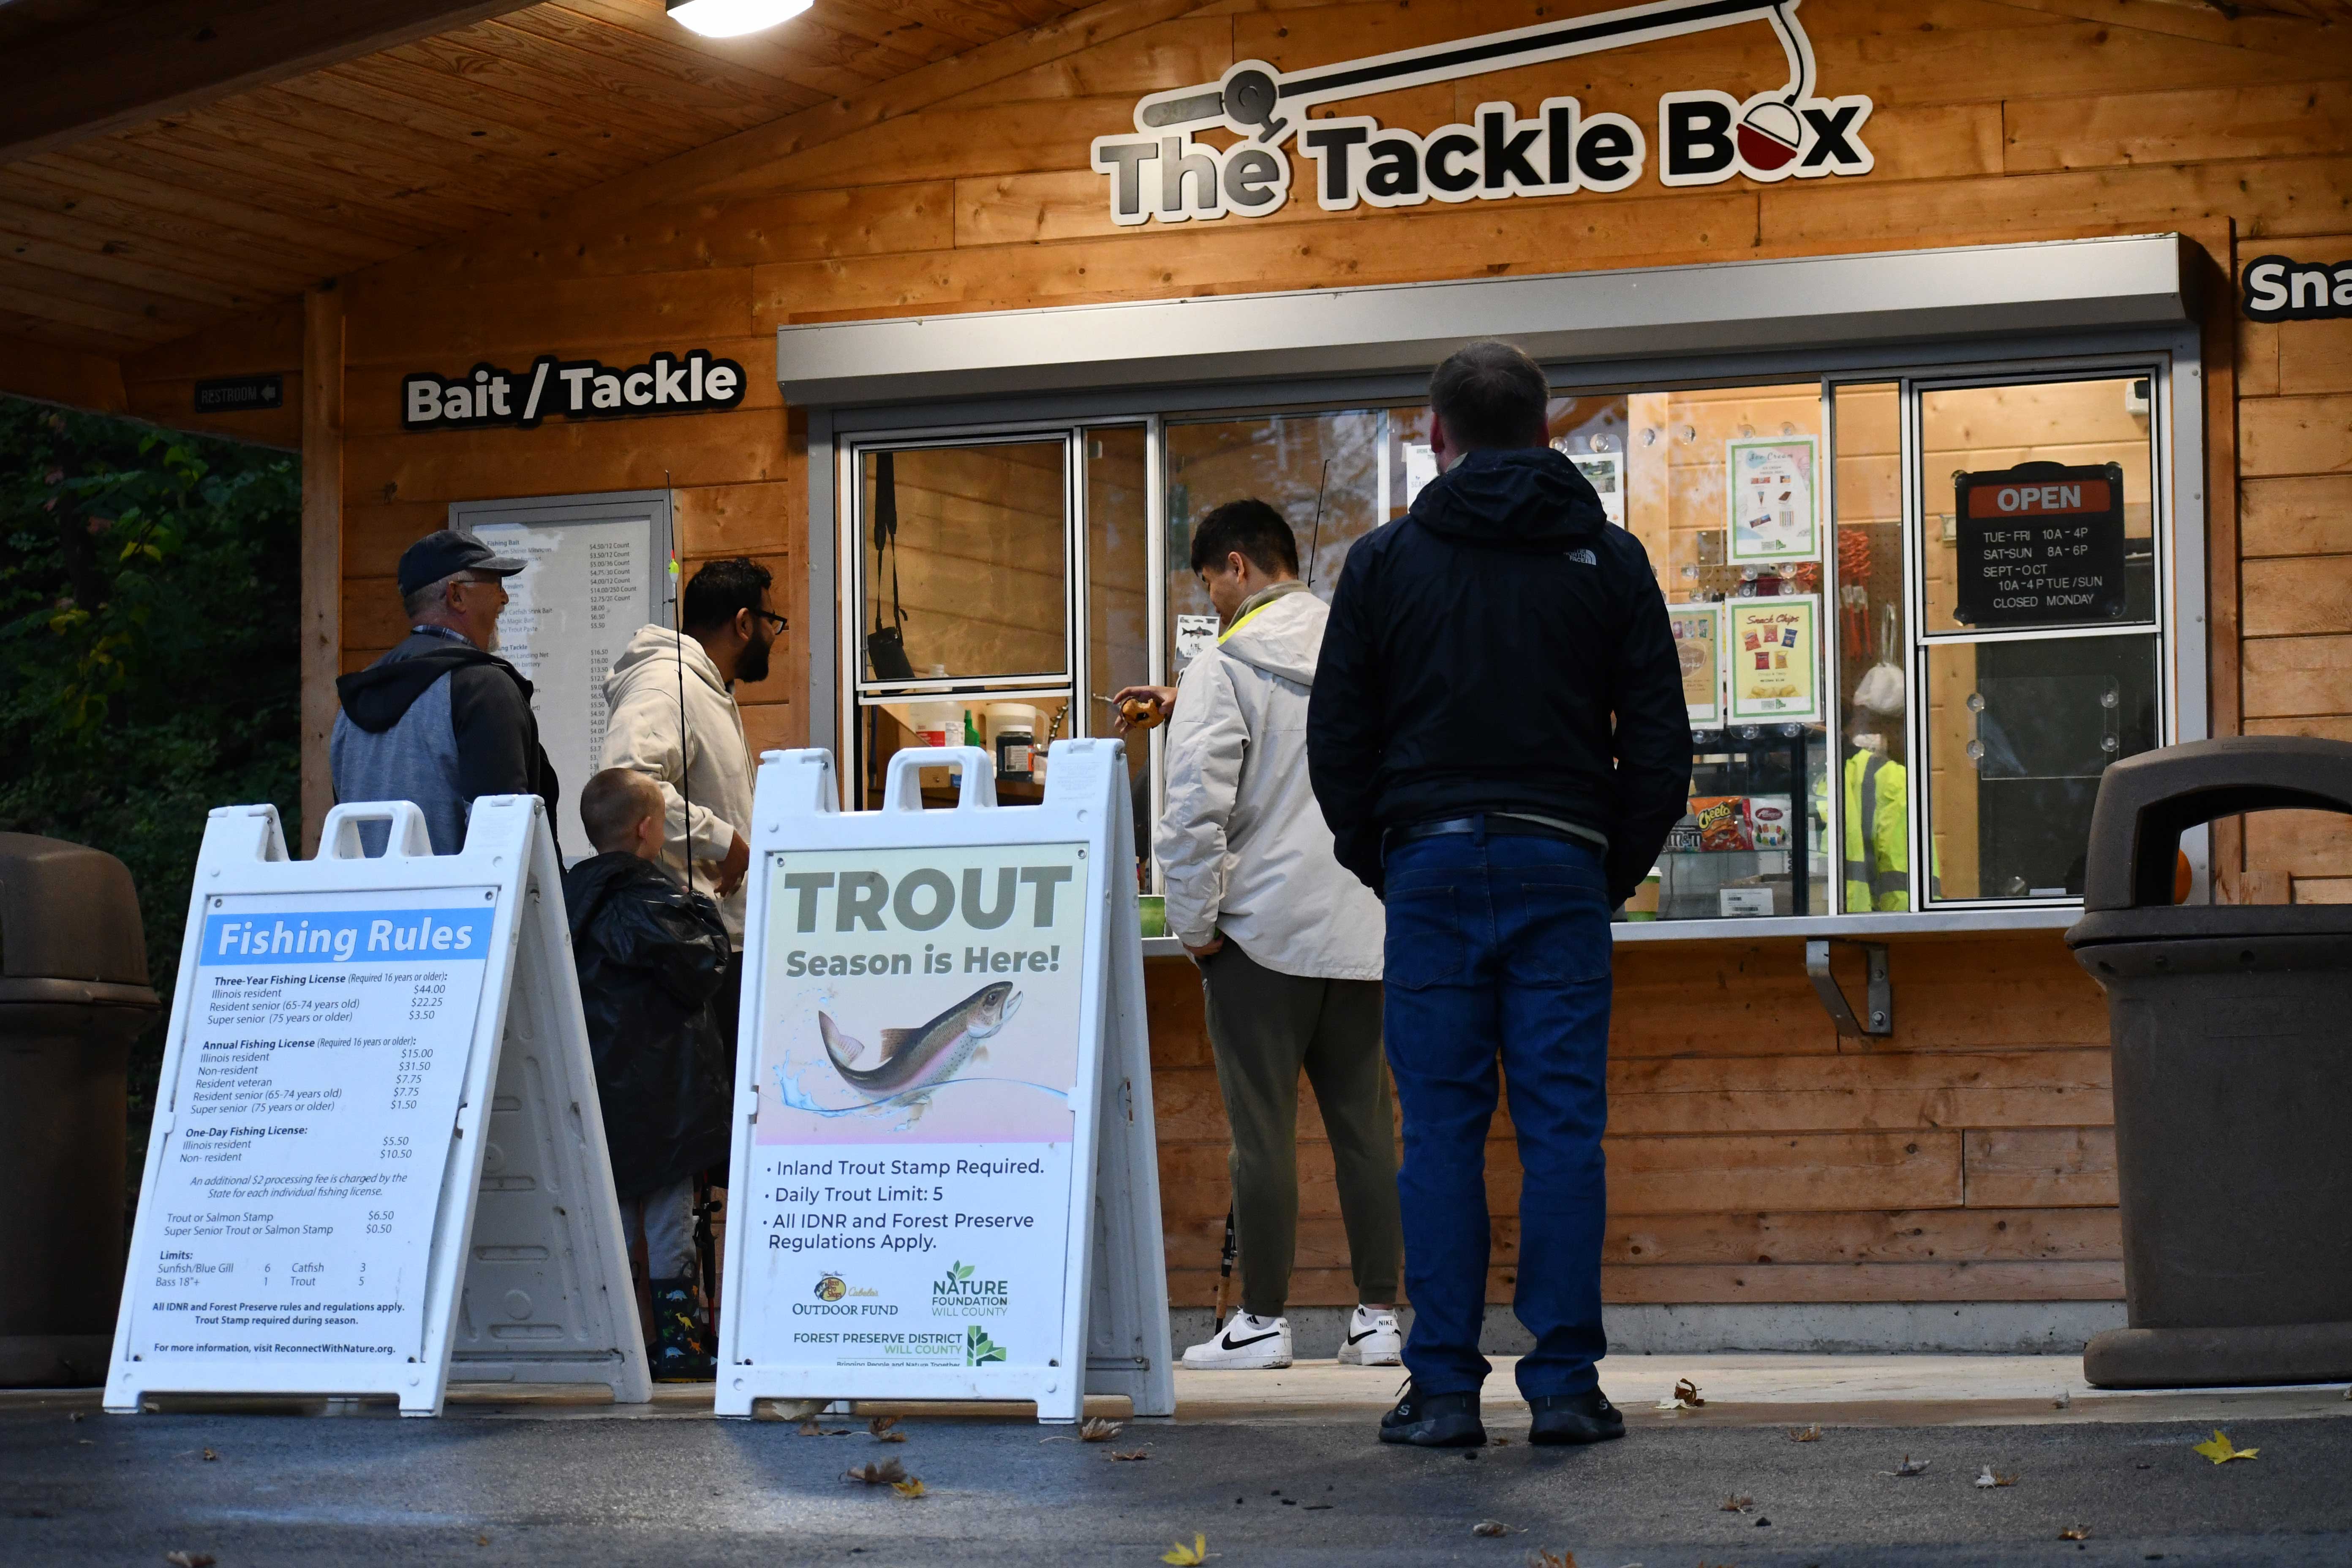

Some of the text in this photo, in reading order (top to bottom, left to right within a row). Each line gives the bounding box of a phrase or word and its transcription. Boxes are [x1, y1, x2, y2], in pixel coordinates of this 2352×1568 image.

[1100, 137, 1280, 215] The
[1307, 106, 1635, 199] Tackle
[201, 387, 257, 403] RESTROOM
[408, 357, 737, 421] Bait / Tackle
[1997, 485, 2081, 511] OPEN
[1993, 593, 2094, 608] CLOSED MONDAY
[1776, 613, 1799, 625] Chips
[784, 866, 1073, 933] TROUT
[219, 917, 473, 962] Fishing Rules
[786, 944, 1060, 977] Season is Here!
[215, 976, 269, 985] Three-Year
[270, 975, 306, 986] Fishing
[309, 975, 346, 983] License
[348, 973, 382, 984] (Required
[394, 975, 412, 983] years
[423, 972, 447, 981] older):
[212, 985, 445, 999] Illinois resident $44.00
[210, 997, 443, 1011] Resident senior (65-74 years old) $22.25
[207, 1015, 234, 1026] Super
[237, 1014, 265, 1024] senior
[270, 1014, 284, 1024] (75
[286, 1015, 310, 1025] years
[325, 1012, 352, 1022] older)
[409, 1010, 435, 1020] $3.50
[198, 1062, 430, 1075] Non-resident $31.50
[196, 1074, 422, 1088] Resident veteran $7.75
[186, 1126, 308, 1138] One-Day Fishing License:
[180, 1149, 412, 1162] Non- resident $10.50
[778, 1158, 1044, 1178] Inland Trout Stamp Required.
[776, 1185, 942, 1205] Daily Trout Limit: 5
[168, 1214, 192, 1222] Trout
[206, 1212, 240, 1222] Salmon
[243, 1212, 273, 1223] Stamp
[368, 1210, 394, 1220] $6.50
[773, 1213, 1034, 1228] All IDNR and Forest Preserve
[769, 1233, 936, 1252] Regulations Apply.
[160, 1250, 193, 1260] Limits:
[158, 1262, 365, 1273] Sunfish/Blue Gill 6 Catfish 3
[156, 1277, 176, 1286] Bass
[264, 1277, 267, 1286] 1
[291, 1277, 316, 1286] Trout
[359, 1277, 364, 1286] 5
[934, 1280, 1008, 1295] NATURE
[827, 1290, 842, 1299] Shops
[932, 1297, 1007, 1306] FOUNDATION
[792, 1303, 898, 1315] OUTDOOR FUND
[932, 1307, 1007, 1316] WILL COUNTY
[794, 1333, 963, 1343] FOREST PRESERVE DISTRICT
[154, 1343, 169, 1352] For
[196, 1343, 251, 1353] information,
[254, 1344, 272, 1352] visit
[275, 1344, 395, 1355] ReconnectWithNature.org.
[885, 1345, 961, 1354] WILL COUNTY
